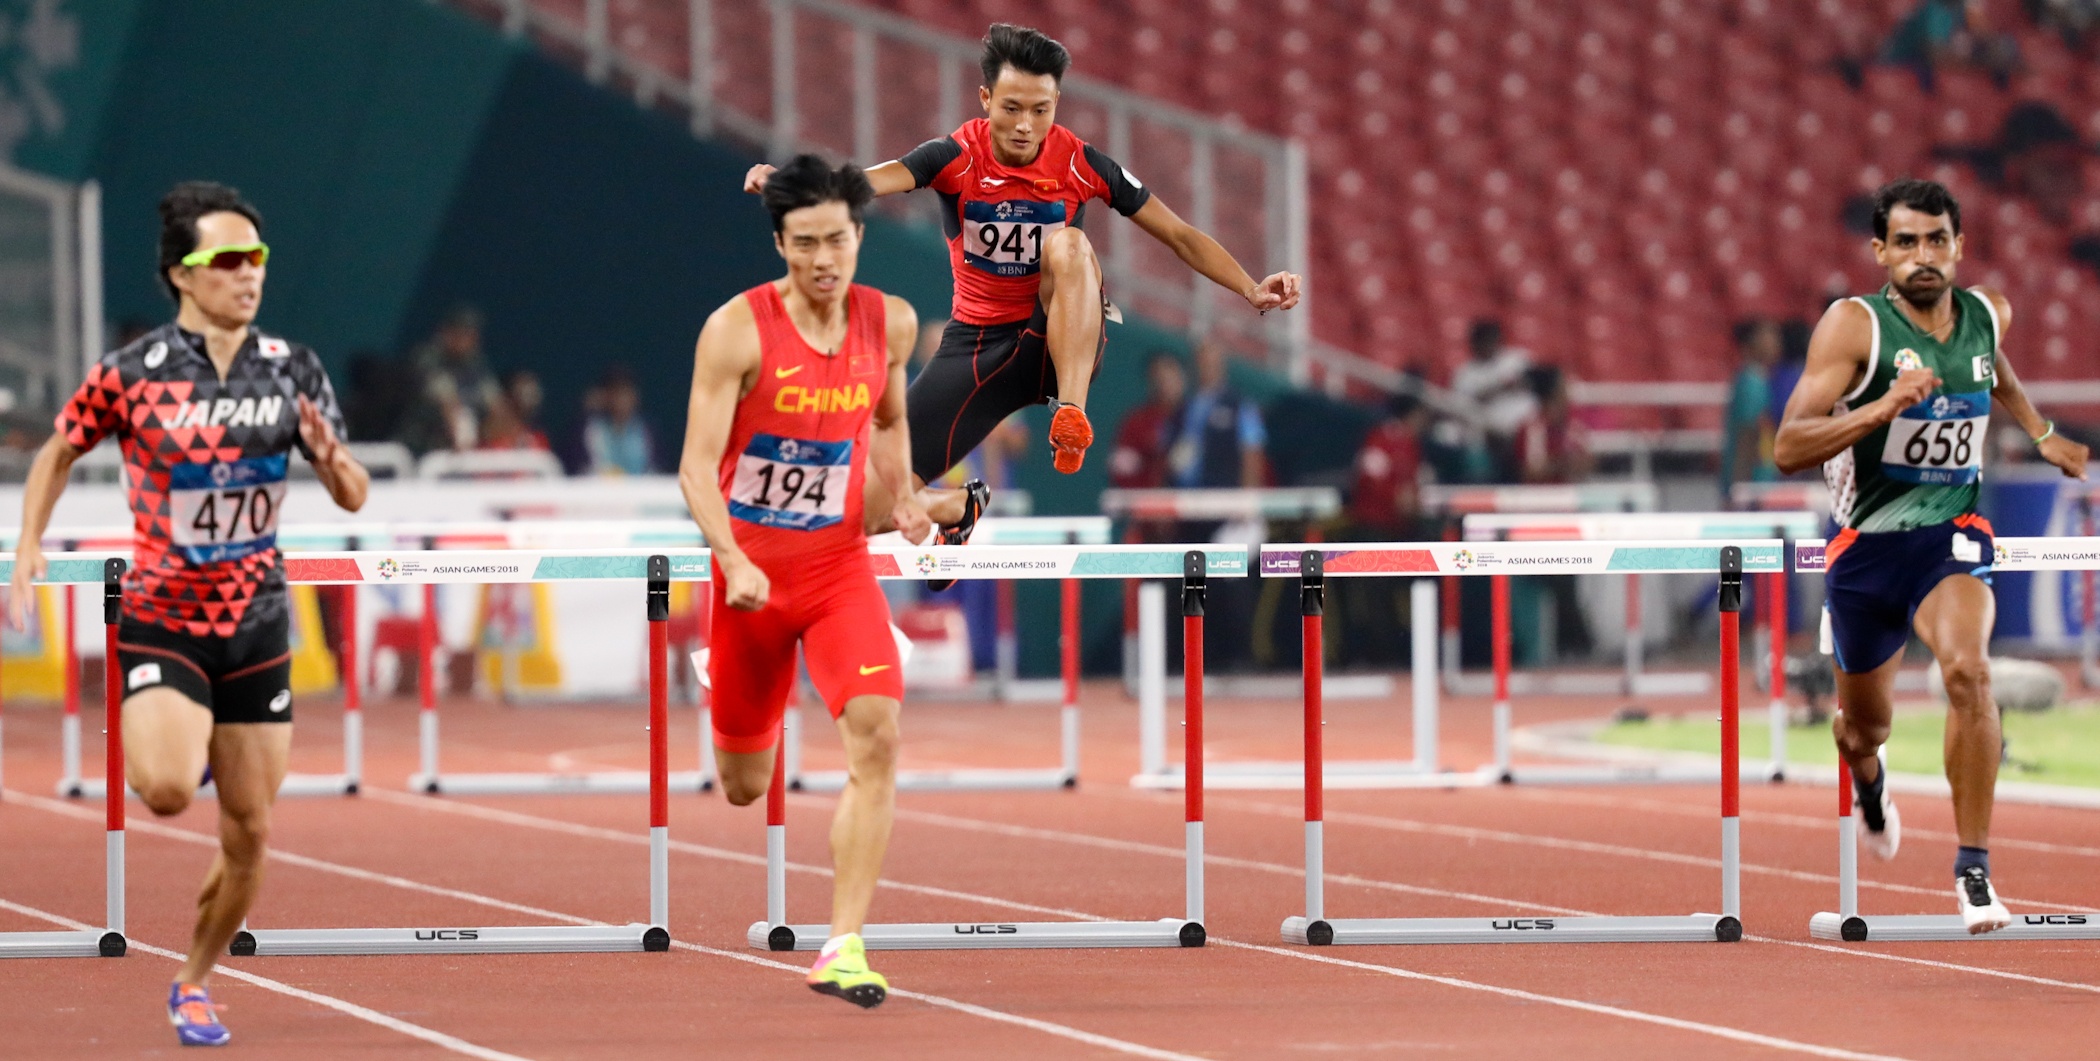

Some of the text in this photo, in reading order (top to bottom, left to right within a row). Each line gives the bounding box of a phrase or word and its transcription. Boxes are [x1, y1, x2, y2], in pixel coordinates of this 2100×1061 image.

[979, 223, 1042, 263] 941
[1007, 266, 1026, 275] BNI
[774, 383, 870, 413] CHINA
[161, 395, 283, 430] JAPAN
[1904, 420, 1973, 466] 658
[752, 462, 829, 510] 194
[192, 487, 271, 541] 470
[1744, 556, 1778, 564] UCS
[2071, 552, 2100, 560] GAME
[497, 565, 519, 573] 2018
[672, 564, 705, 572] UCS
[1208, 560, 1242, 568] UCS
[1266, 560, 1300, 568] UCS
[1492, 919, 1554, 930] UCS
[2024, 915, 2087, 925] UCS
[954, 925, 1017, 934] UCS
[415, 930, 478, 940] UCS
